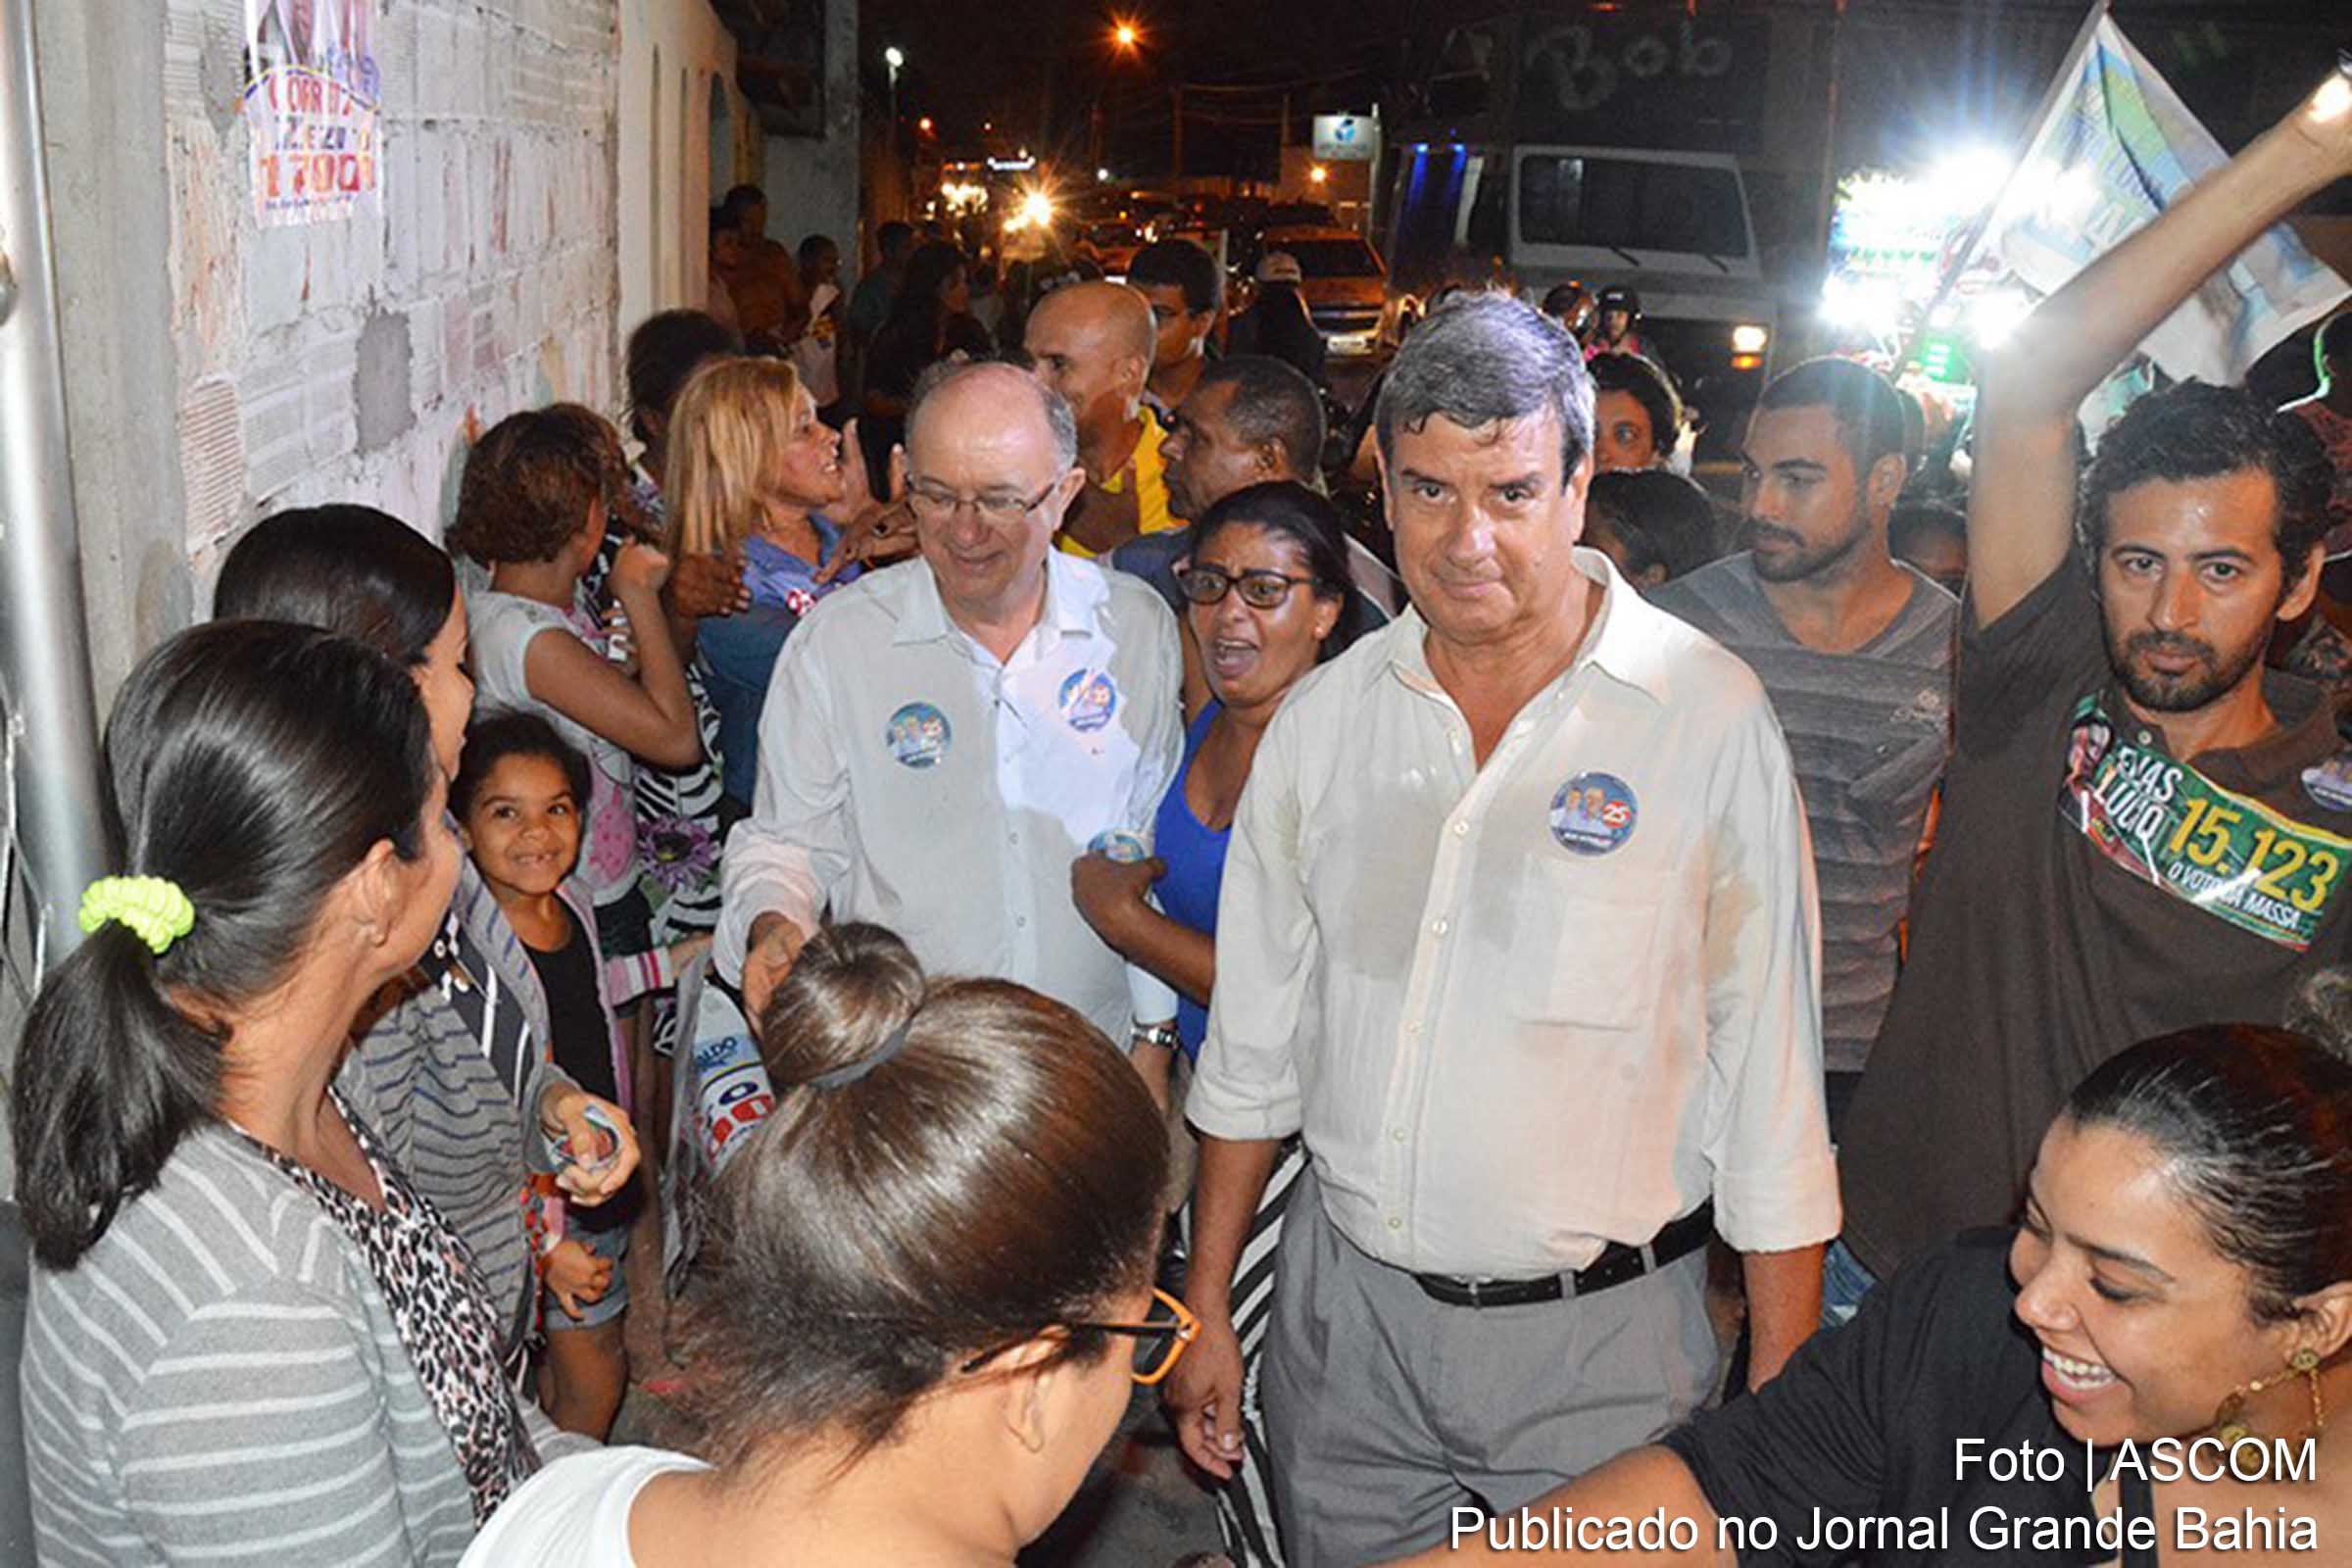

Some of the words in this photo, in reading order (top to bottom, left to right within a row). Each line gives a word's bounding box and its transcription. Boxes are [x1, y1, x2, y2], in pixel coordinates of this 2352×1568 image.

[1525, 24, 1733, 110] Bob
[1603, 804, 1628, 823] 25
[2169, 799, 2339, 911] 15.123
[2242, 891, 2301, 930] MASSA
